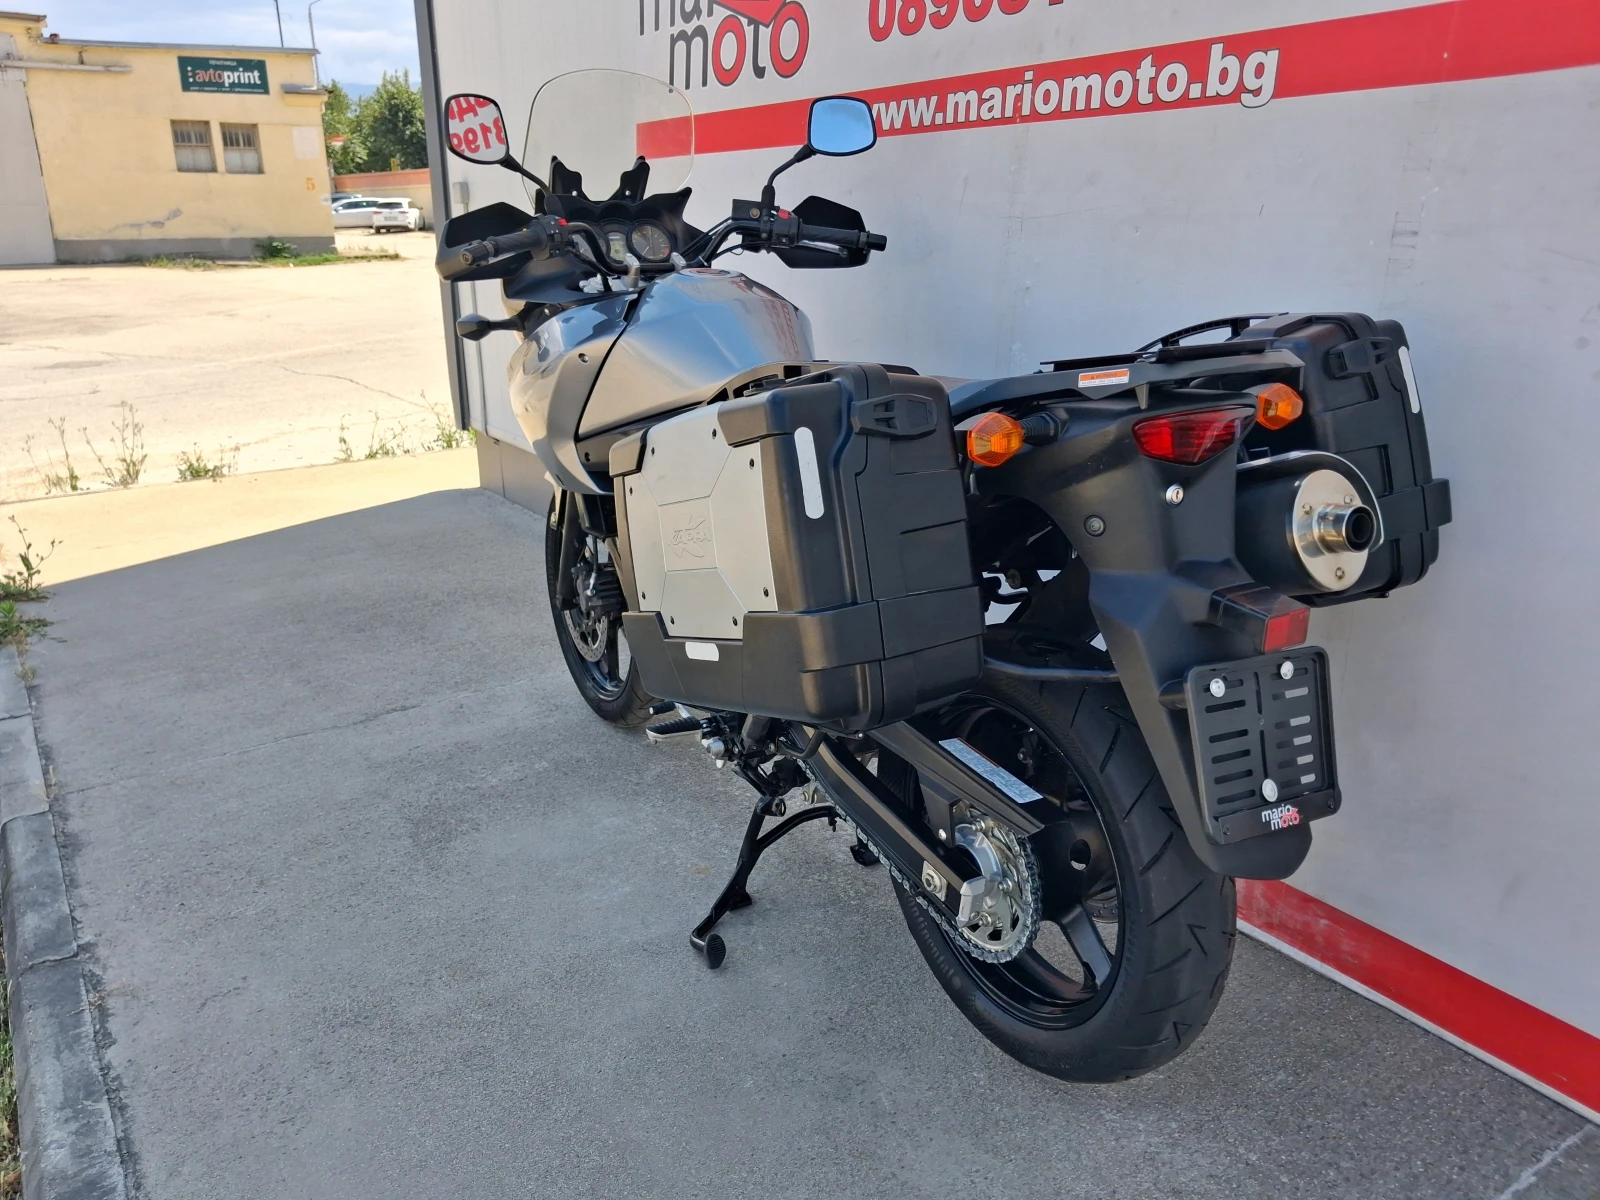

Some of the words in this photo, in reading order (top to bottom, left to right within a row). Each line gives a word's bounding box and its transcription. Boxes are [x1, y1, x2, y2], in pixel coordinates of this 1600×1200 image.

[669, 1, 809, 93] moto
[195, 67, 262, 87] avtoprint
[872, 42, 1280, 131] ww.mariomoto.bg
[305, 177, 316, 191] 5
[1262, 804, 1293, 823] mario
